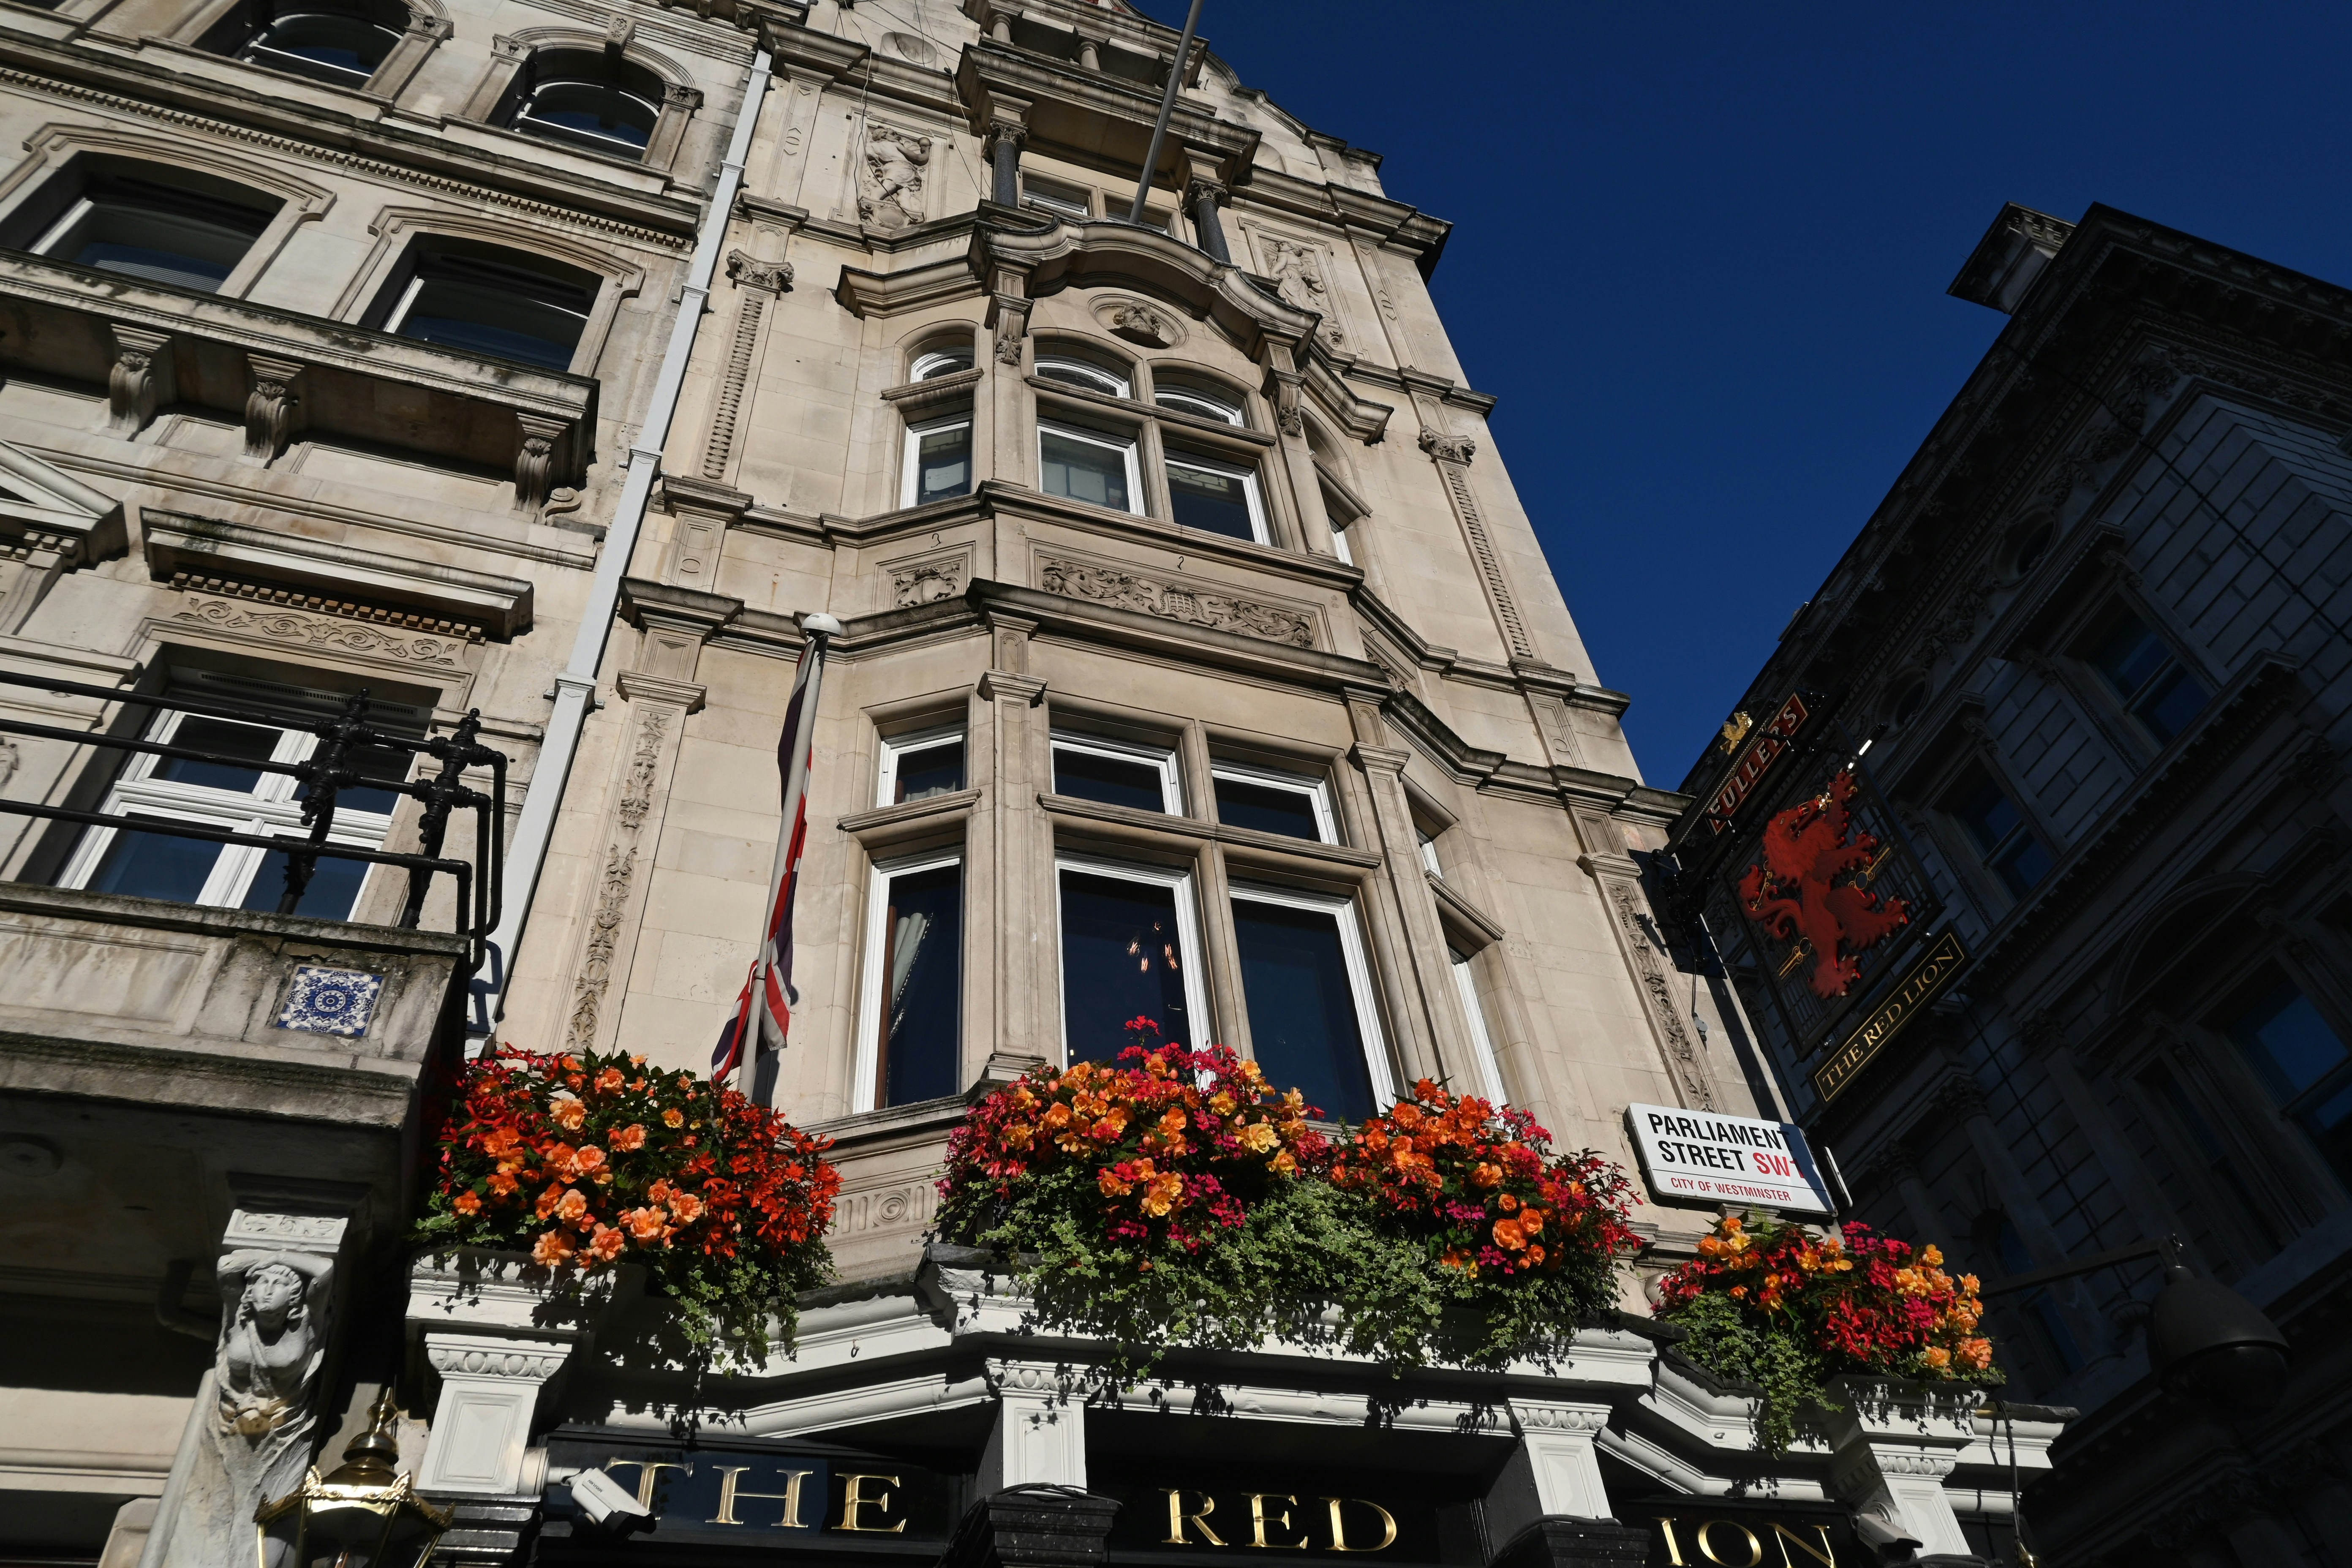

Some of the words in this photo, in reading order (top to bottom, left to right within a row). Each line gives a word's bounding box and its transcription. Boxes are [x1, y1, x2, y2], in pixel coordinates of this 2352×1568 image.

[1822, 1043, 1864, 1088] THE
[1862, 1003, 1901, 1048] RED
[1903, 945, 1954, 1005] LION
[1647, 1113, 1792, 1151] PARLIAMENT
[1658, 1140, 1745, 1171] STREET
[1753, 1152, 1805, 1179] SW1
[1671, 1177, 1694, 1190] CITY
[1698, 1181, 1712, 1192] OF
[1714, 1182, 1792, 1201] WESTMINSTER
[603, 1457, 906, 1533] THE
[1158, 1487, 1397, 1552] RED
[1651, 1516, 1838, 1568] ION
